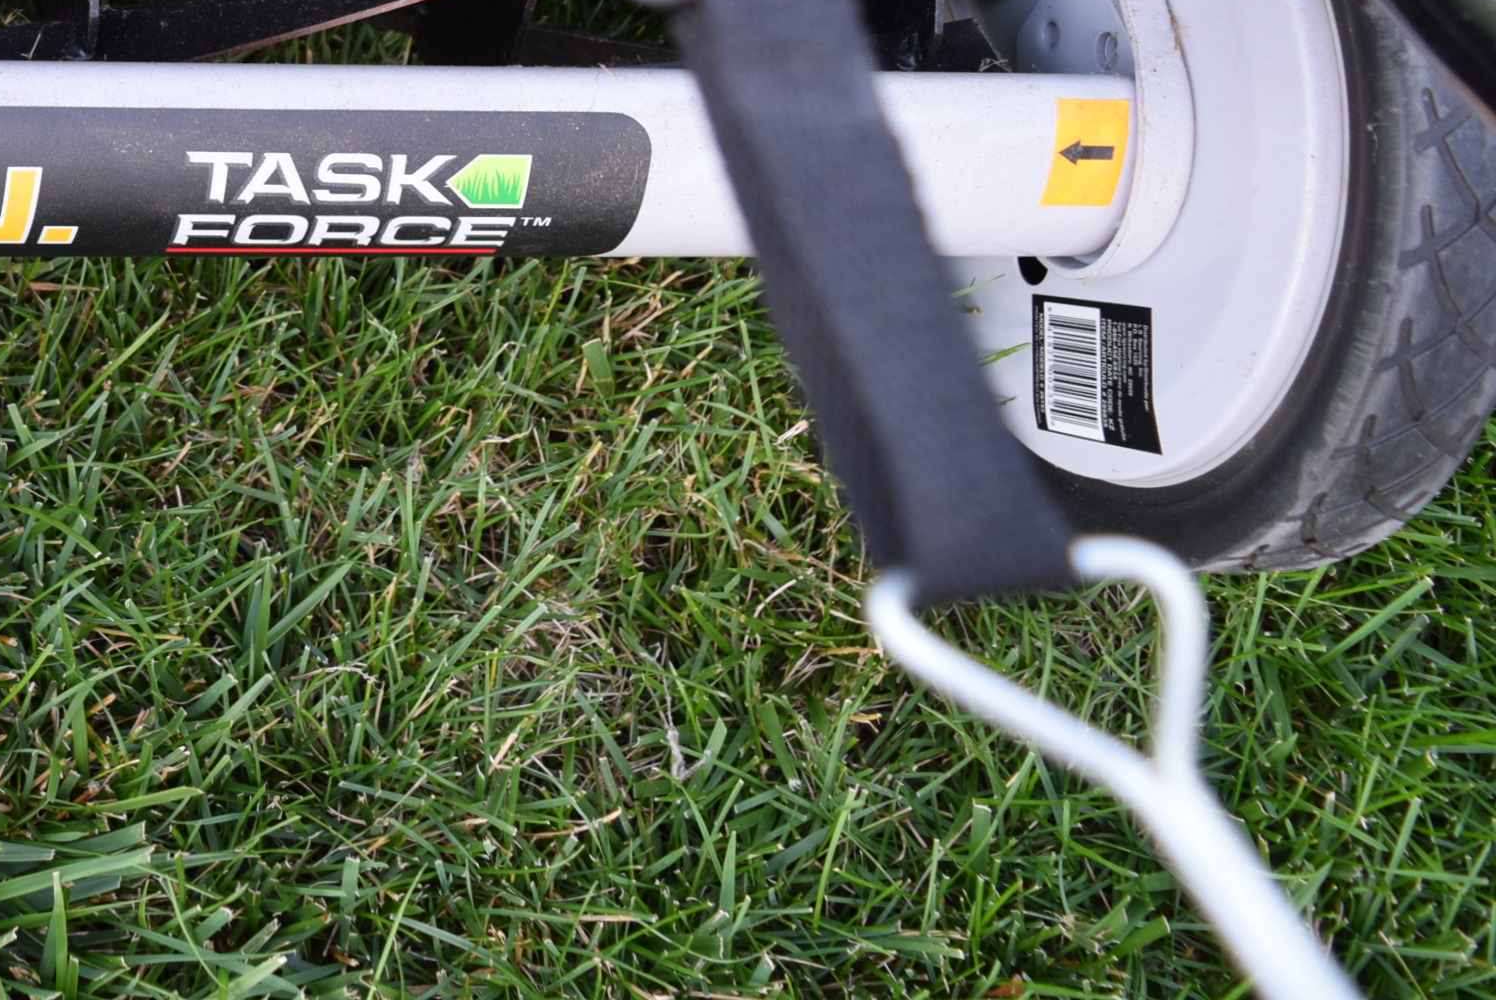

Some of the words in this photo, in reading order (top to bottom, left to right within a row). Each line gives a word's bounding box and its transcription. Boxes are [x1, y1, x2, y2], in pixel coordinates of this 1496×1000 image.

[186, 151, 458, 206] TASK
[170, 214, 516, 247] FORCE
[1128, 367, 1133, 376] NC
[1118, 390, 1122, 398] de
[1108, 419, 1115, 431] KZ
